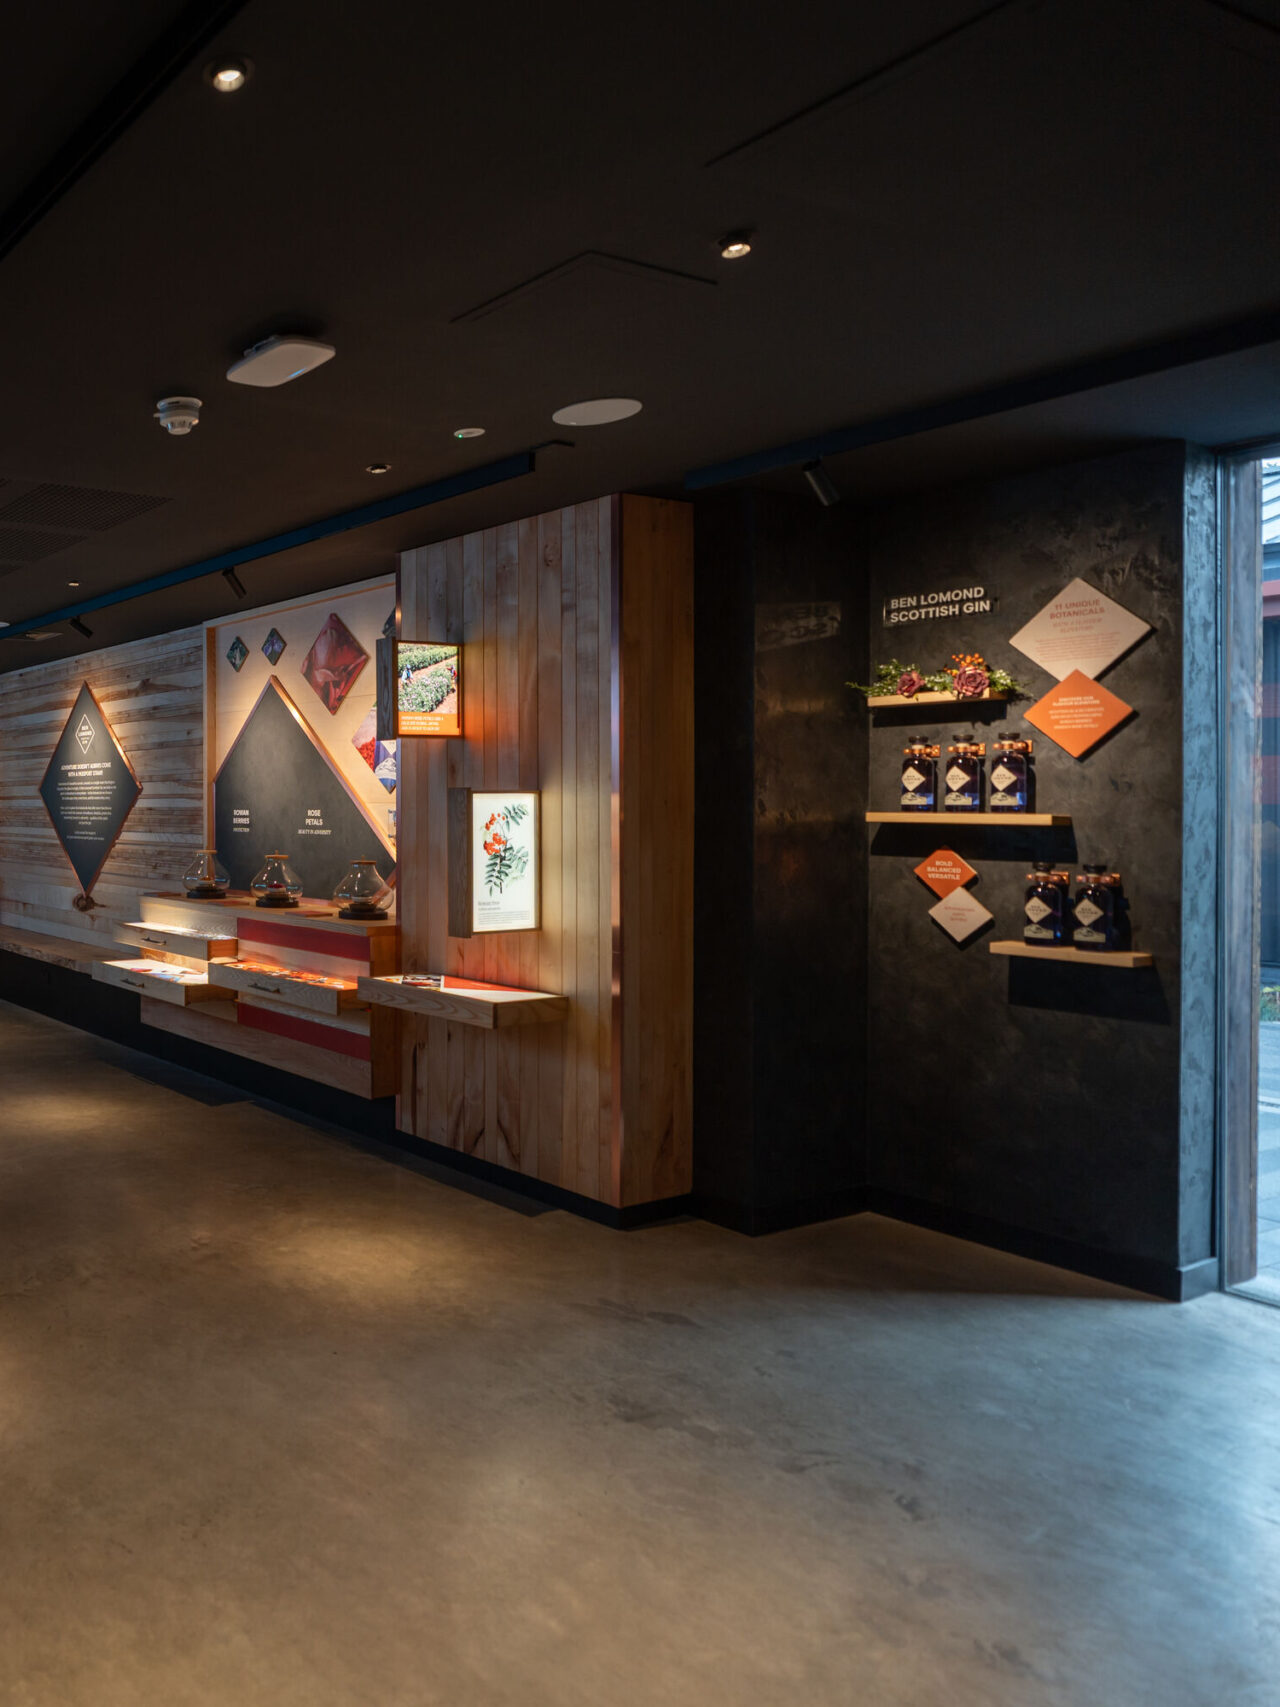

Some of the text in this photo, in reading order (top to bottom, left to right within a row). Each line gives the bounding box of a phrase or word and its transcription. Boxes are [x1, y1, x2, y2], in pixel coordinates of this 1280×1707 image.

[890, 586, 985, 609] BEN LOMOND
[1065, 598, 1100, 610] UNIQUE
[890, 599, 991, 623] SCOTTISH GIN
[1049, 607, 1105, 620] BOTANICALS
[307, 809, 321, 817] ROSE
[305, 818, 324, 826] PETALS
